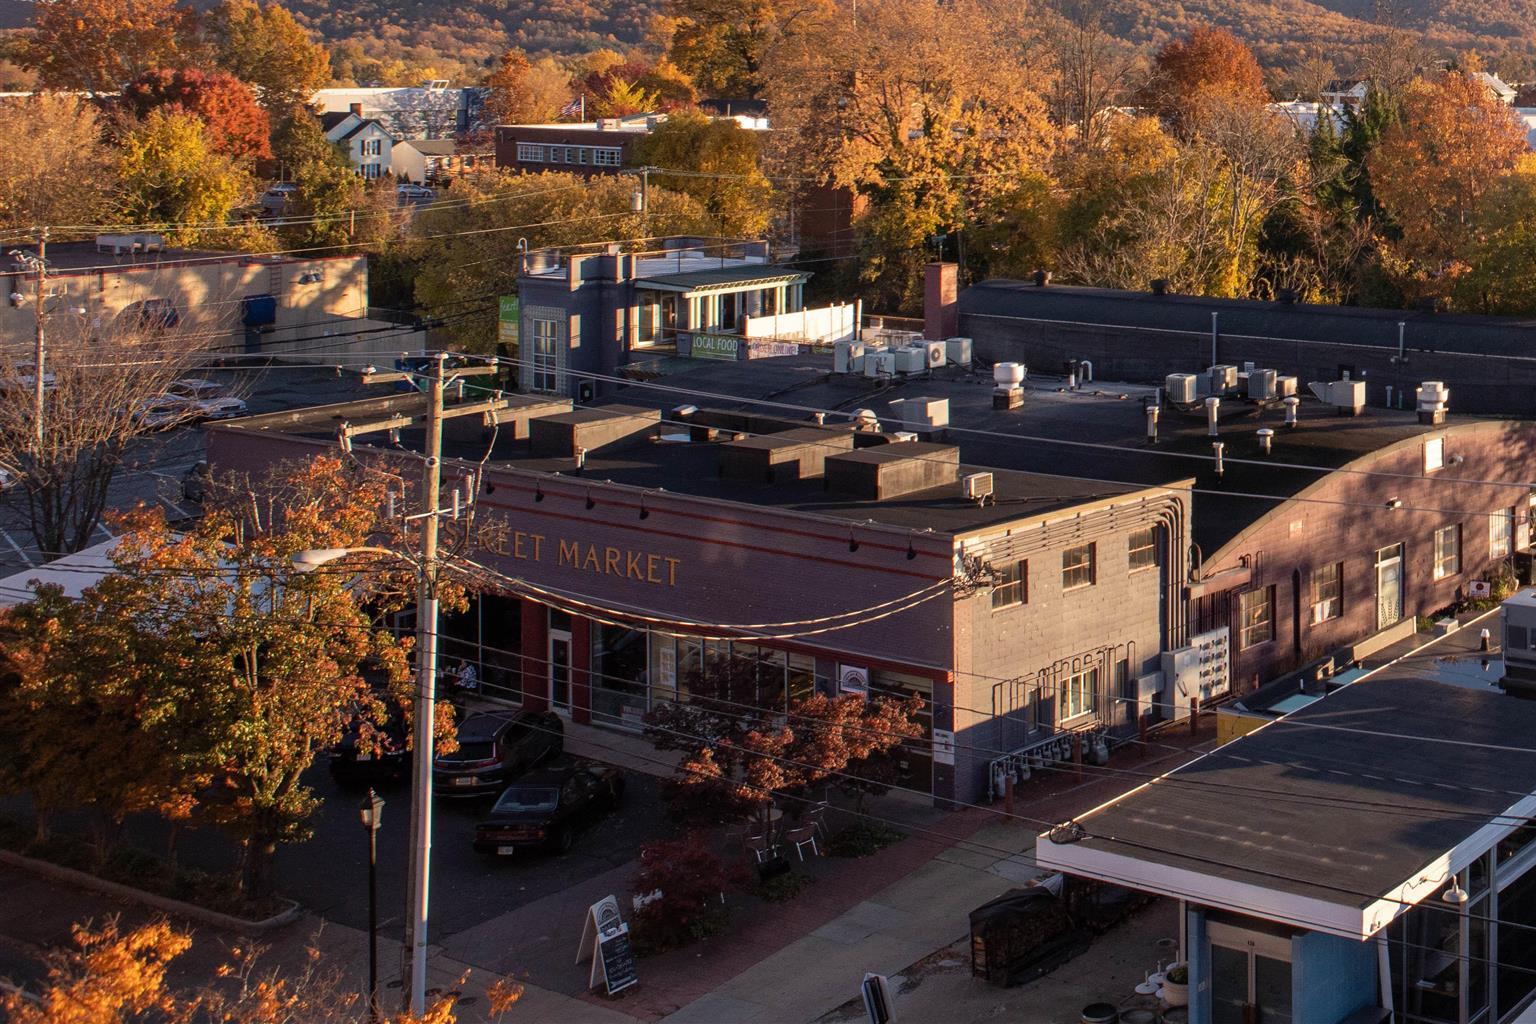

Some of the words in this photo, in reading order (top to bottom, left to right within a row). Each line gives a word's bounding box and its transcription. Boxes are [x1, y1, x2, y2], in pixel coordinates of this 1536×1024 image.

[693, 336, 715, 350] LOCAL
[717, 338, 738, 352] FOOD
[558, 538, 681, 587] MARKET
